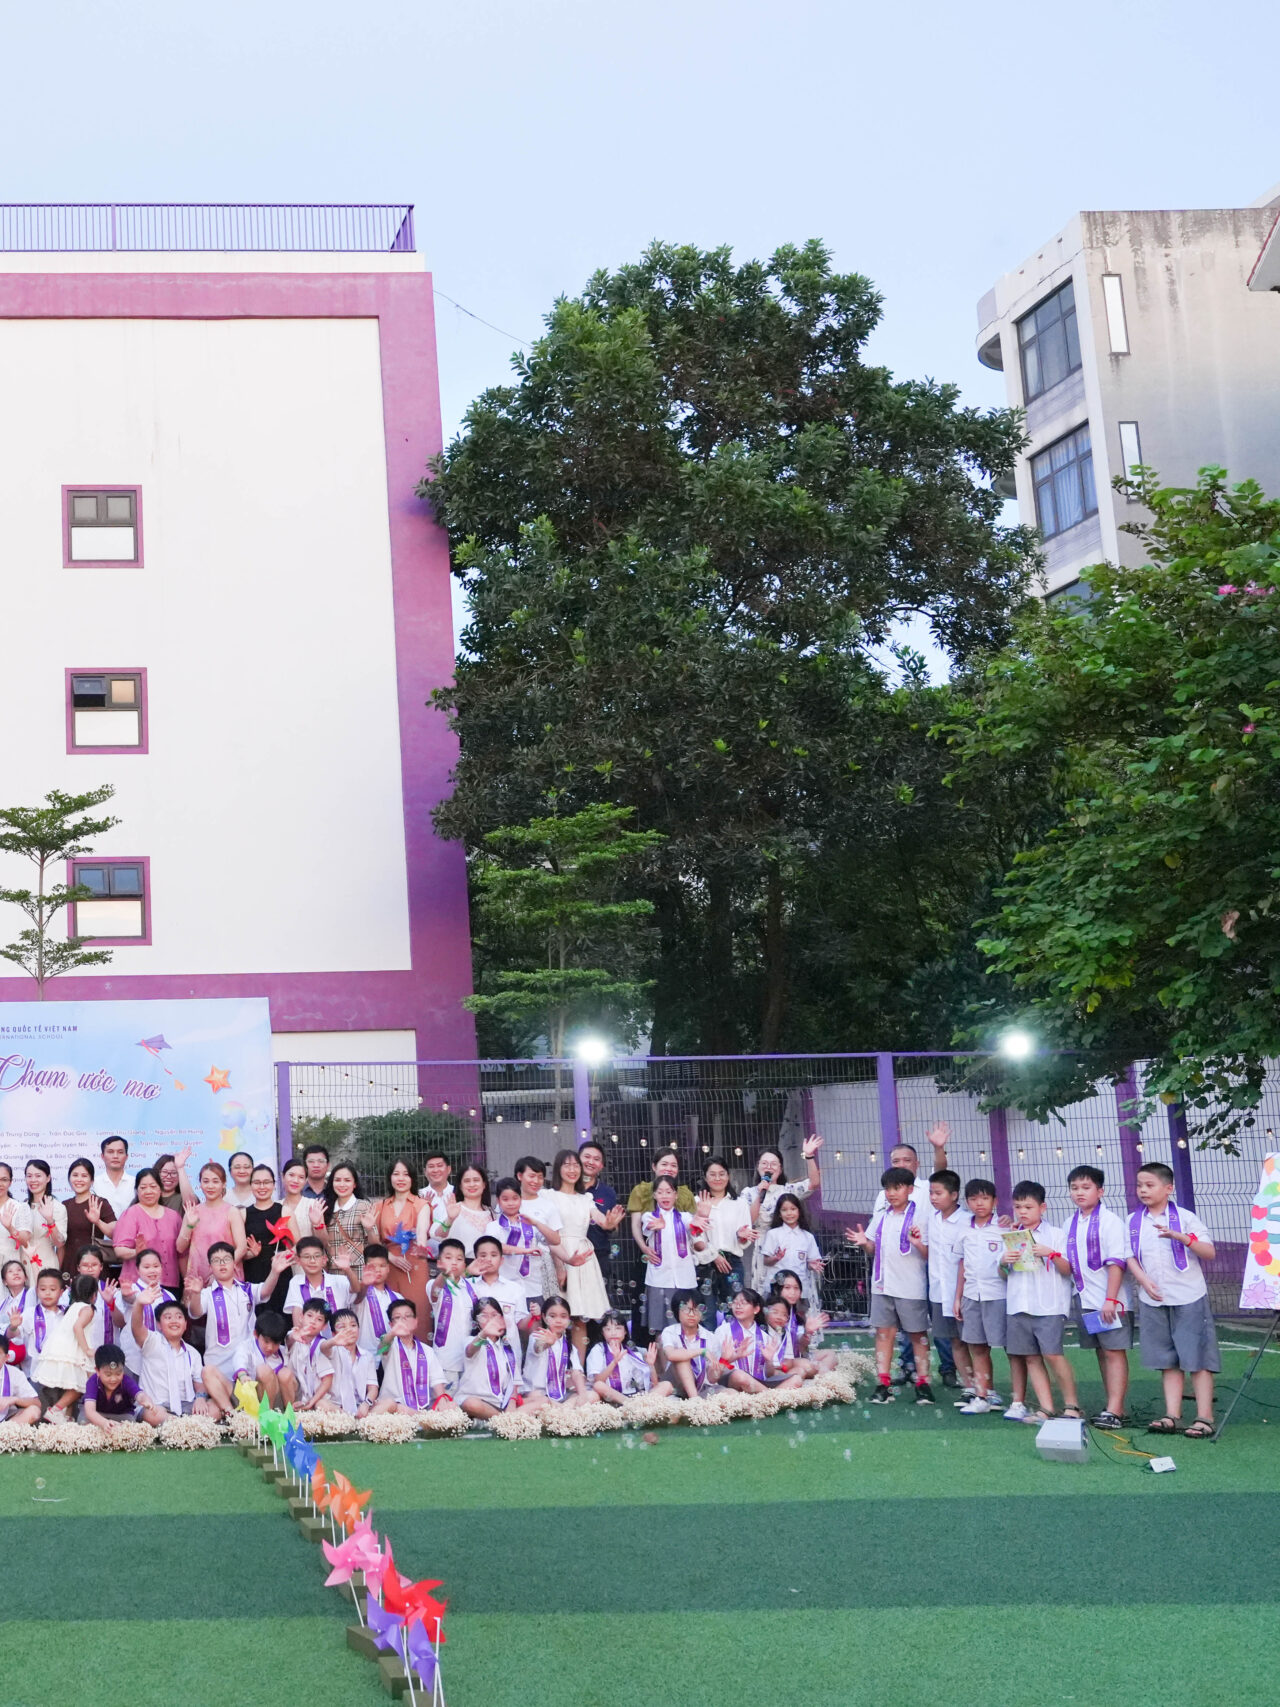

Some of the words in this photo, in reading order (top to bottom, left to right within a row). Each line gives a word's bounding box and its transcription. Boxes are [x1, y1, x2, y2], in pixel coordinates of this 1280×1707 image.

[13, 1023, 32, 1033] QUỐC
[44, 1024, 60, 1033] VIỆT
[77, 1068, 117, 1093] ước
[122, 1079, 161, 1100] mơ
